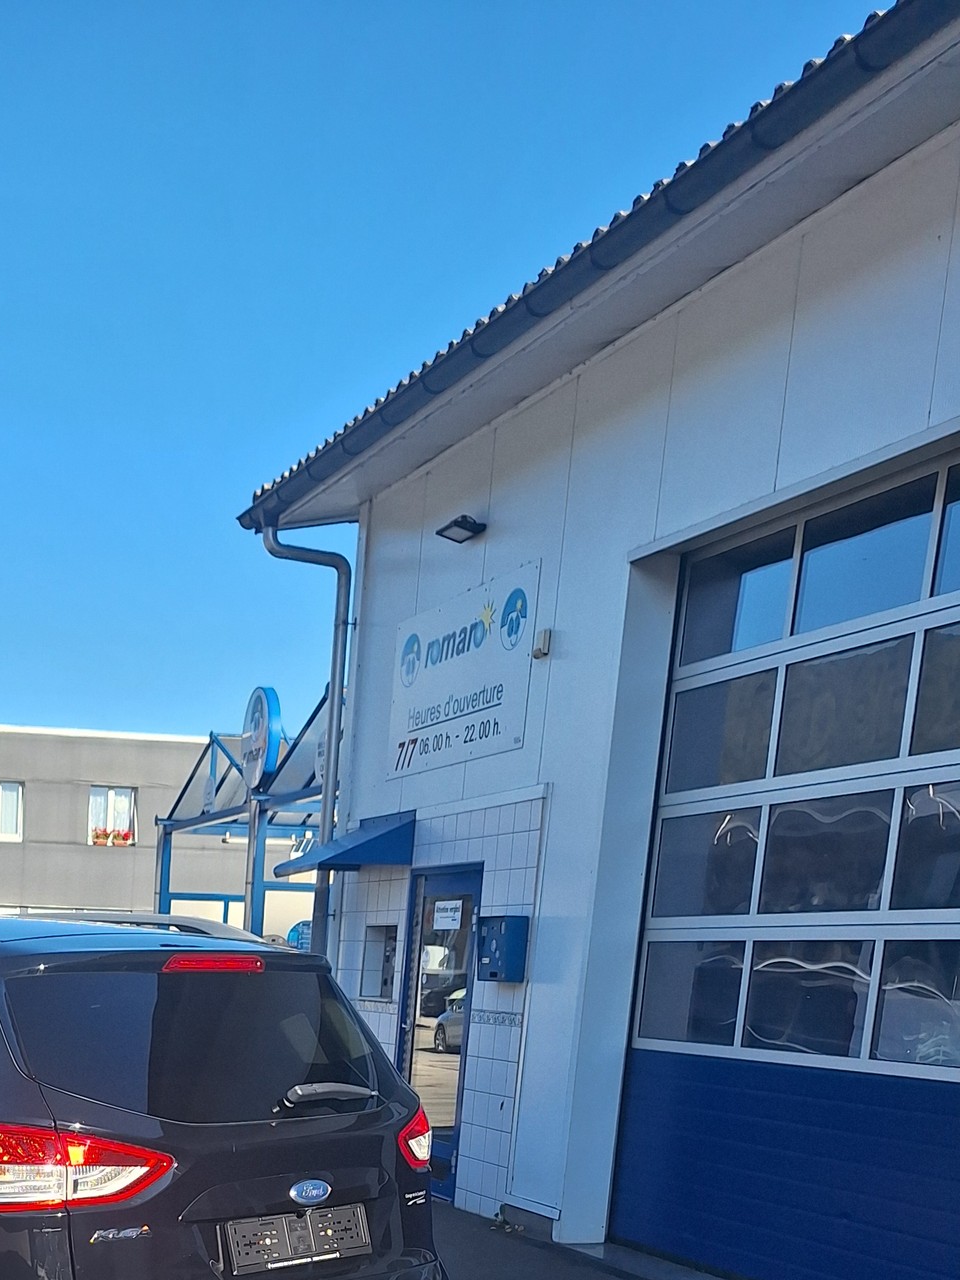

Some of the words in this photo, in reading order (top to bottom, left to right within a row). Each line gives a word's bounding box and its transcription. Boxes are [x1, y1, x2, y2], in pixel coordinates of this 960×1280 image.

[425, 620, 486, 669] romaro
[407, 703, 441, 729] Heures
[444, 683, 504, 717] d'ouverture
[395, 737, 419, 772] 7/7
